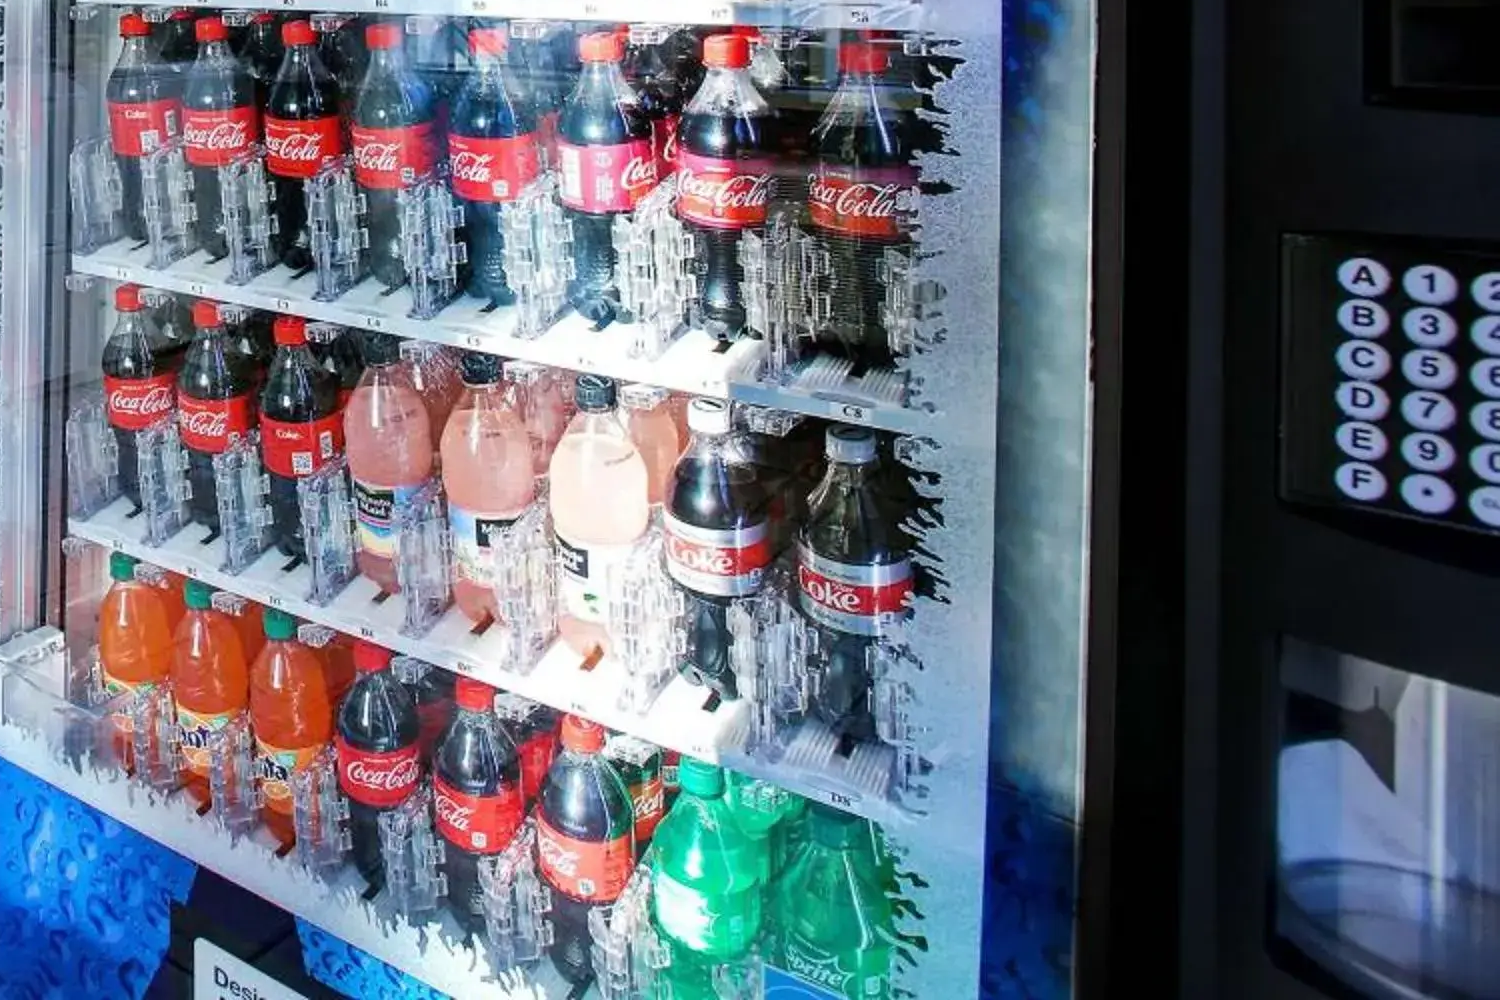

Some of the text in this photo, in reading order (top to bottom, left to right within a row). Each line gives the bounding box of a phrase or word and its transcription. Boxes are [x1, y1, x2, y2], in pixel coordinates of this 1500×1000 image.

[676, 167, 772, 208] Coca-Cola
[807, 173, 898, 217] Coca-Cola
[1352, 265, 1436, 294] A 1
[1352, 305, 1440, 335] B 3
[1351, 346, 1439, 378] C 5
[110, 386, 173, 416] Coca-Cola
[842, 405, 863, 419] C8
[1352, 386, 1438, 419] D 7
[1352, 428, 1438, 461] E 9
[1352, 469, 1371, 489] F
[671, 539, 733, 577] Coke
[801, 565, 860, 608] Coke
[347, 756, 420, 790] Coca-Cola
[788, 944, 844, 986] Sprite
[214, 965, 266, 1000] Desi
